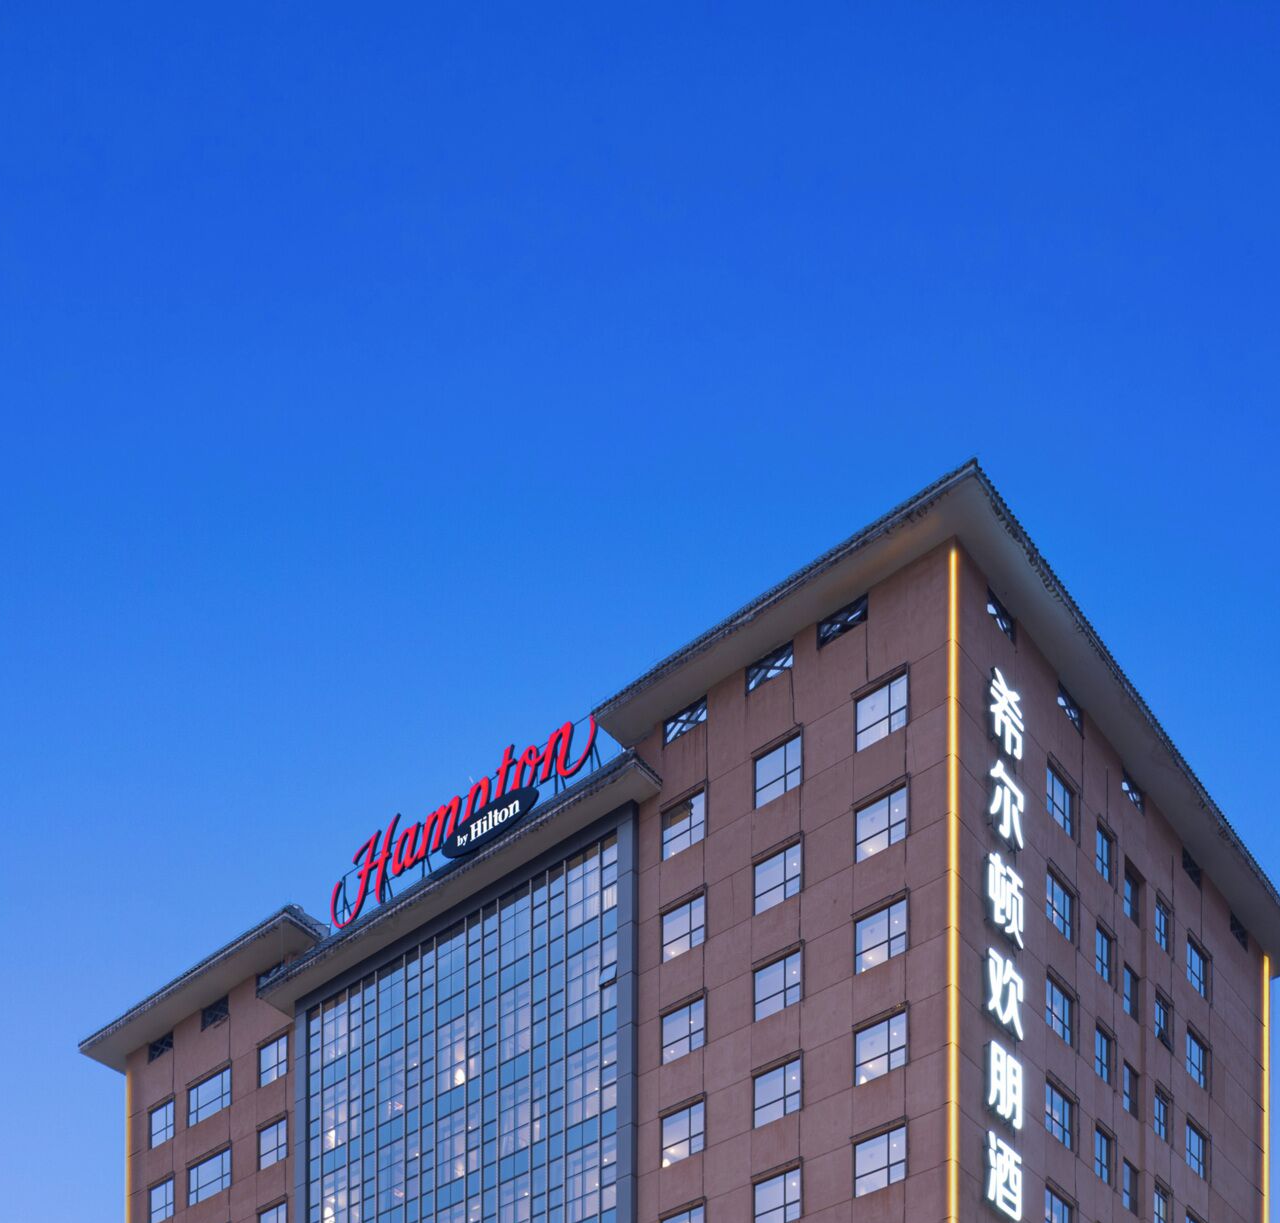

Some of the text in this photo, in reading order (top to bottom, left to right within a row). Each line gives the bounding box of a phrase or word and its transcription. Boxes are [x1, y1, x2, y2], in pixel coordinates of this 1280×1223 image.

[330, 714, 598, 929] Hampton
[457, 800, 521, 847] by Hilton
